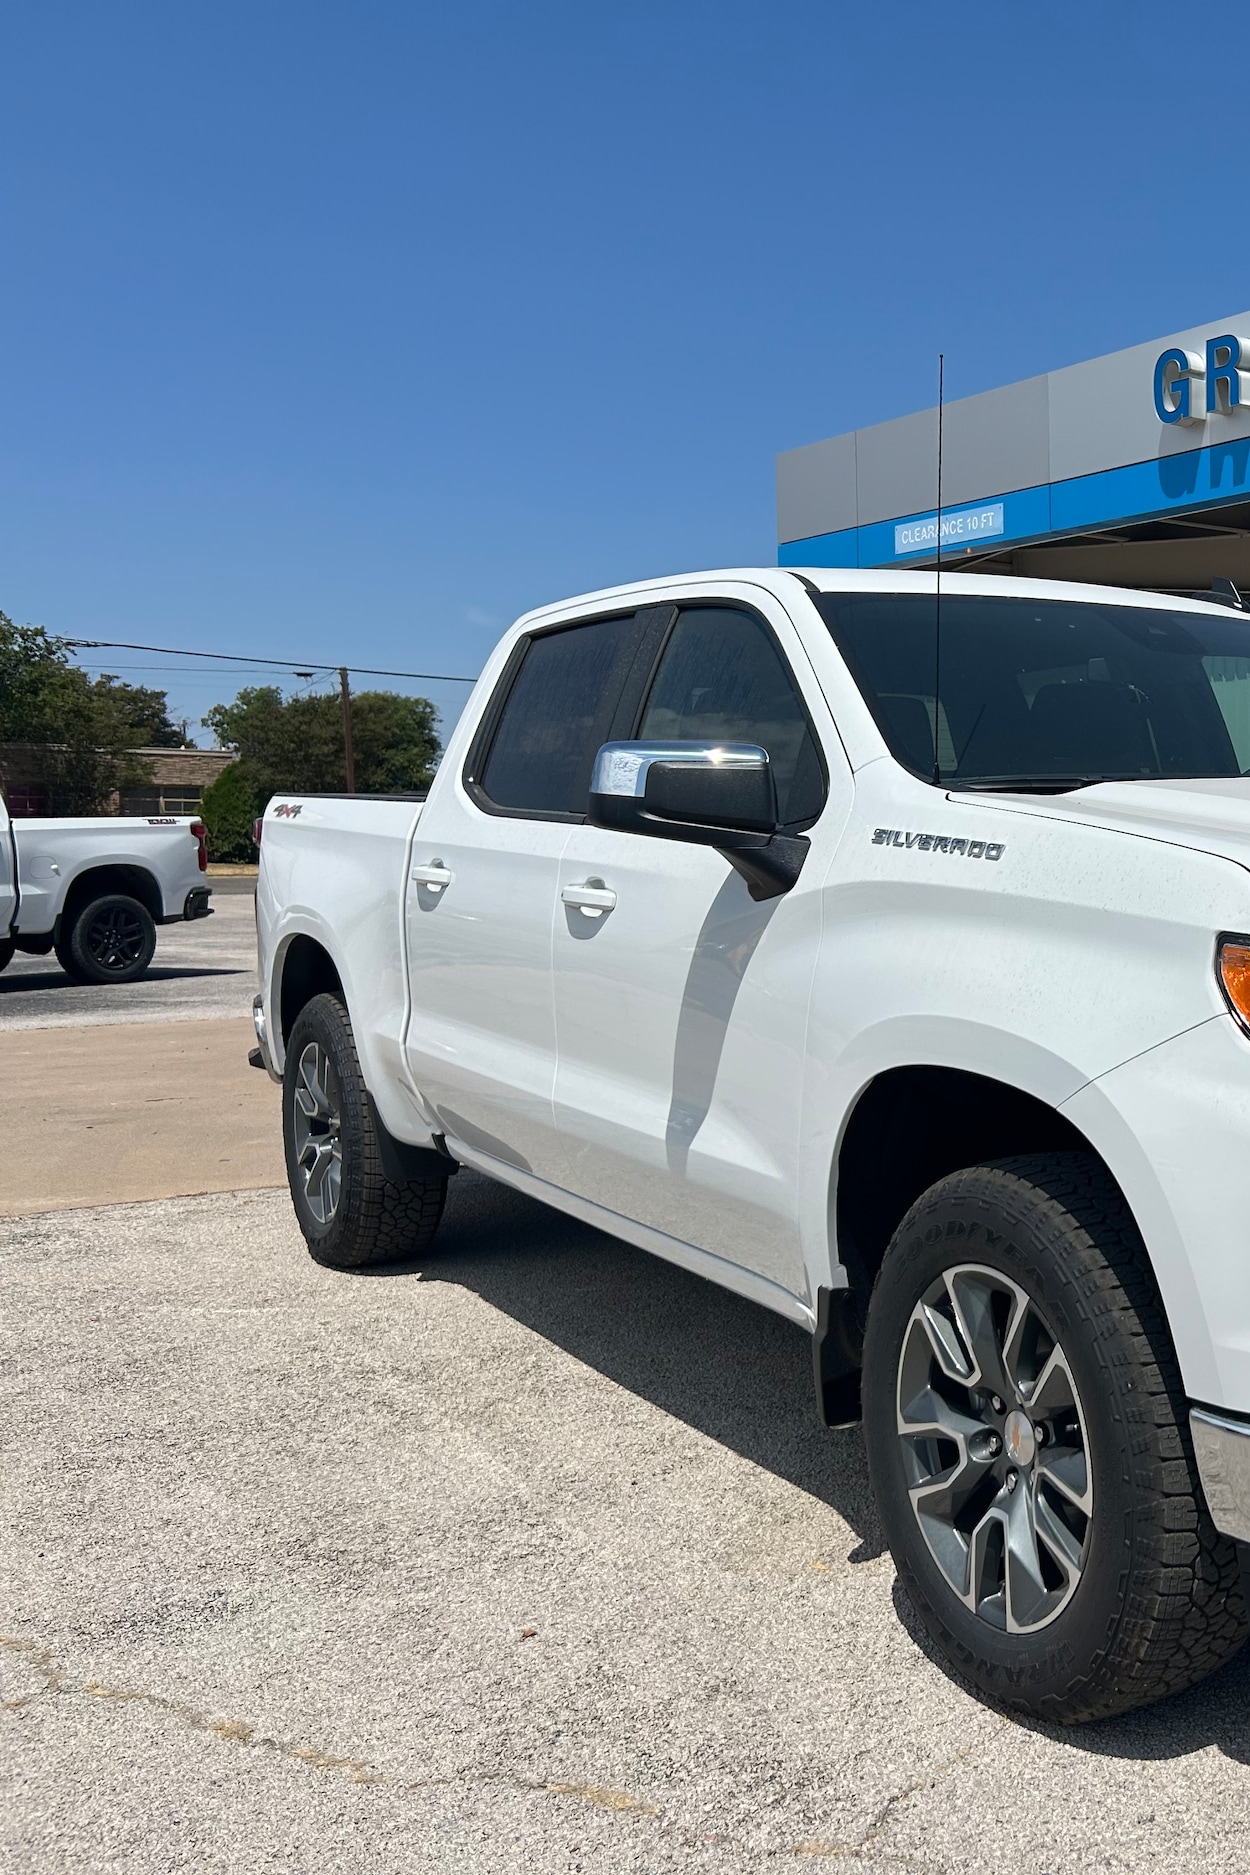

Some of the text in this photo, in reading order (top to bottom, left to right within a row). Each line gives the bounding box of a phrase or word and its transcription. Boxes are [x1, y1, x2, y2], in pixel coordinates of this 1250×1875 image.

[902, 512, 995, 545] CLEARANCE 10 FT
[871, 828, 1007, 861] SILVERADO
